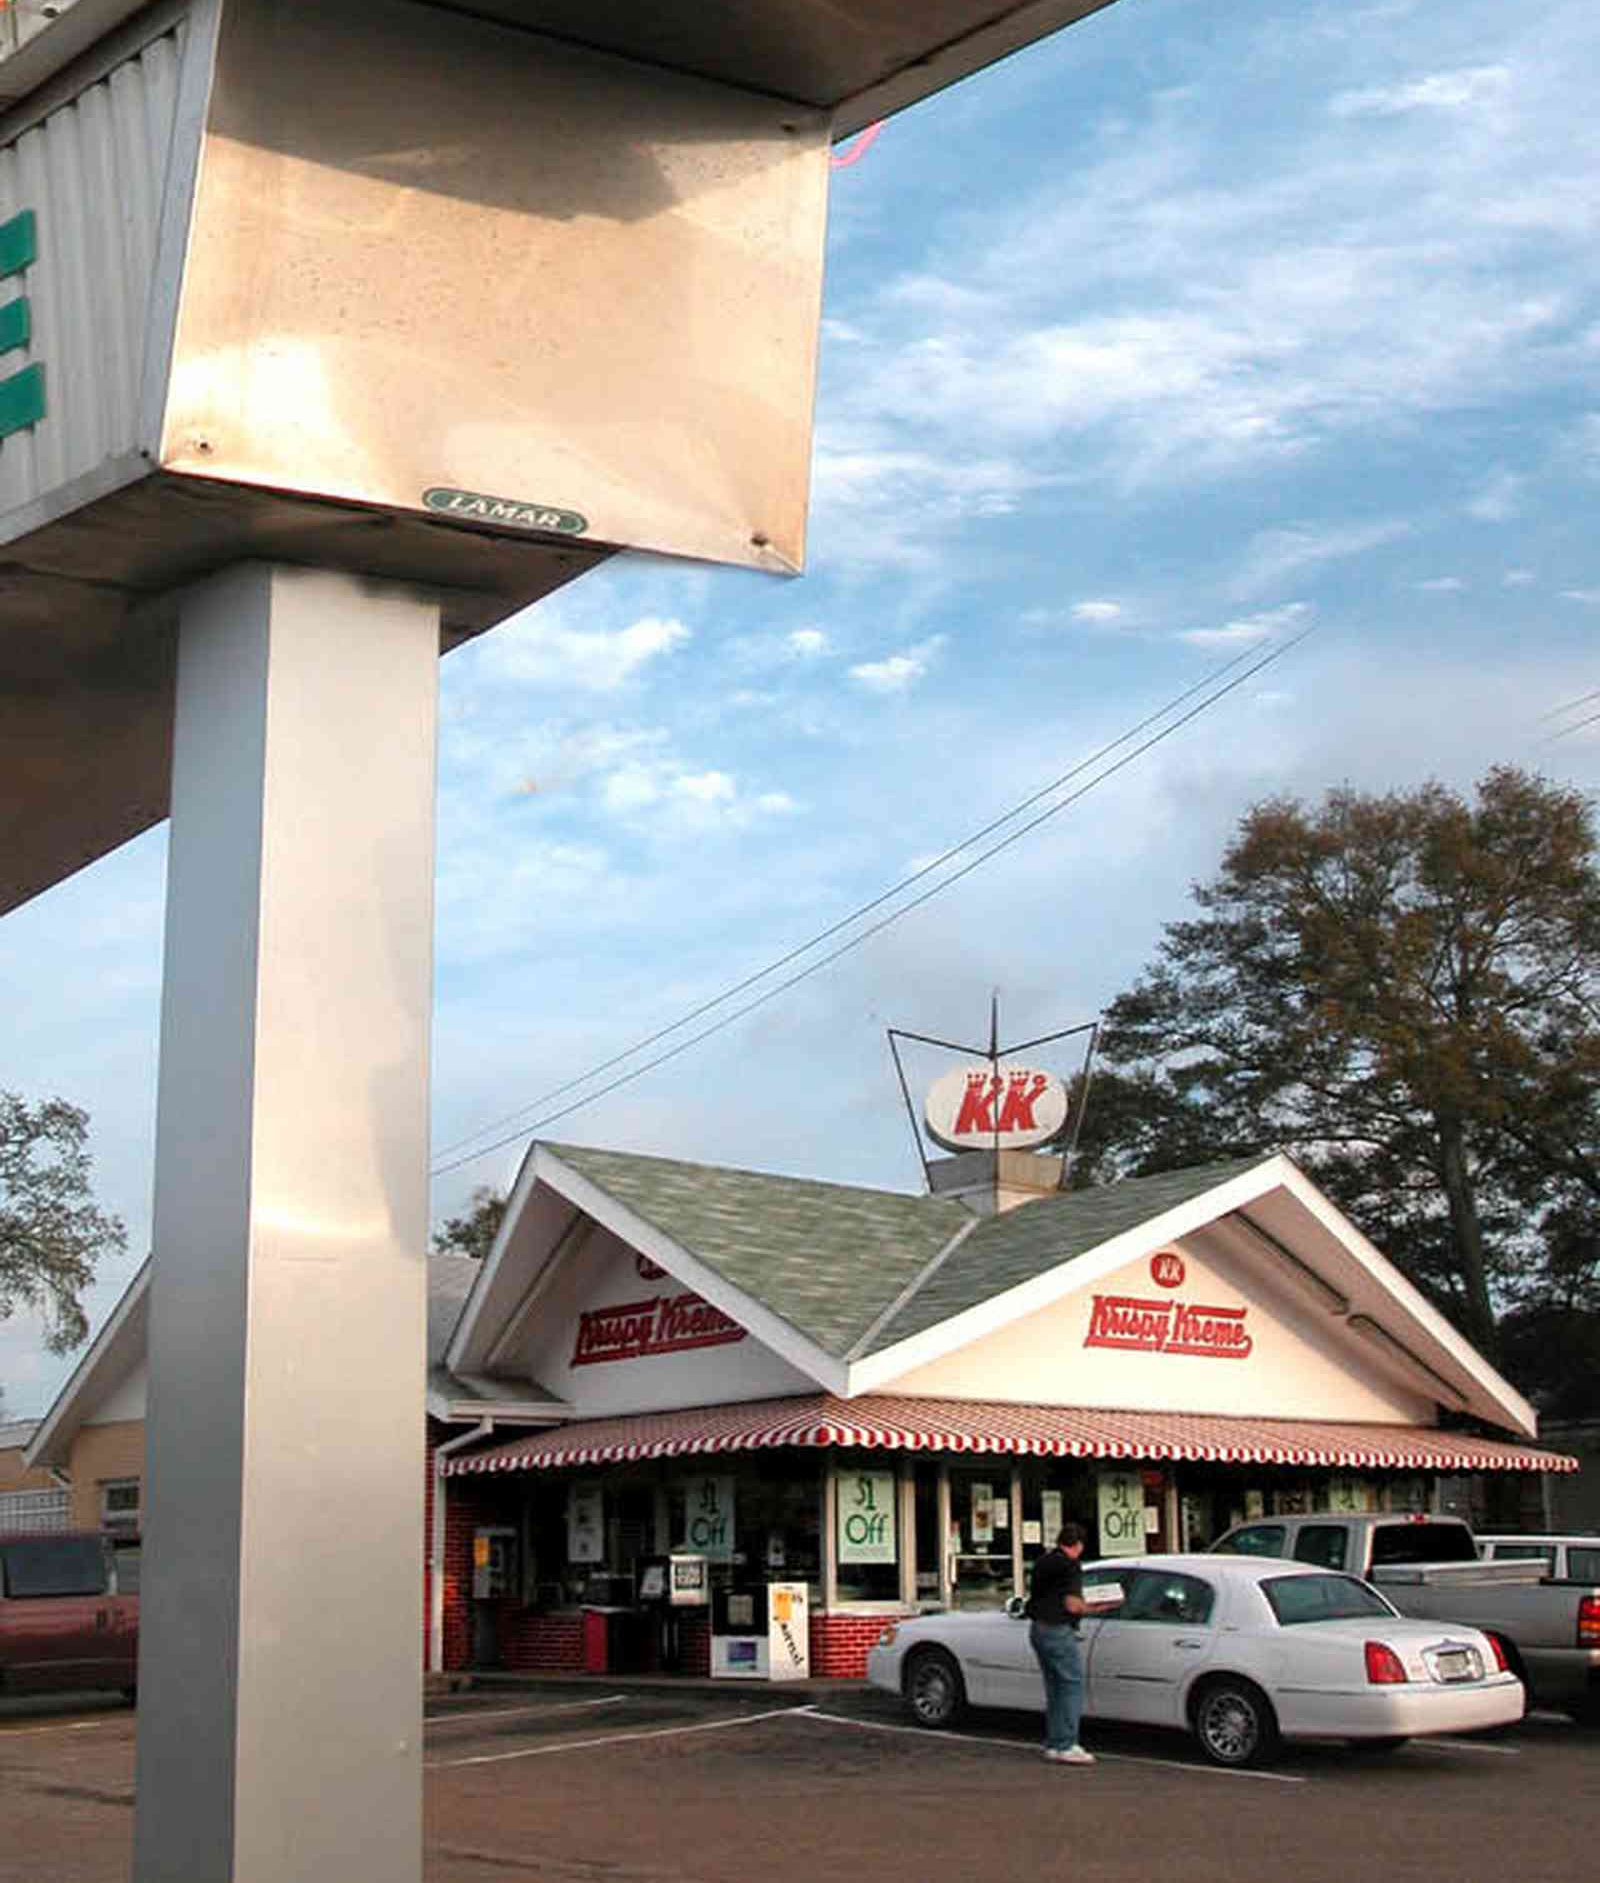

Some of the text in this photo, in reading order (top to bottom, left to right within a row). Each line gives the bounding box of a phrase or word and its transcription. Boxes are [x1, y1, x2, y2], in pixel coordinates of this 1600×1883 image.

[449, 495, 561, 527] LAMAR
[954, 1071, 1048, 1134] KK
[1083, 1295, 1253, 1359] Krispy Kreme
[845, 1513, 889, 1544] Off
[1104, 1510, 1140, 1539] Off
